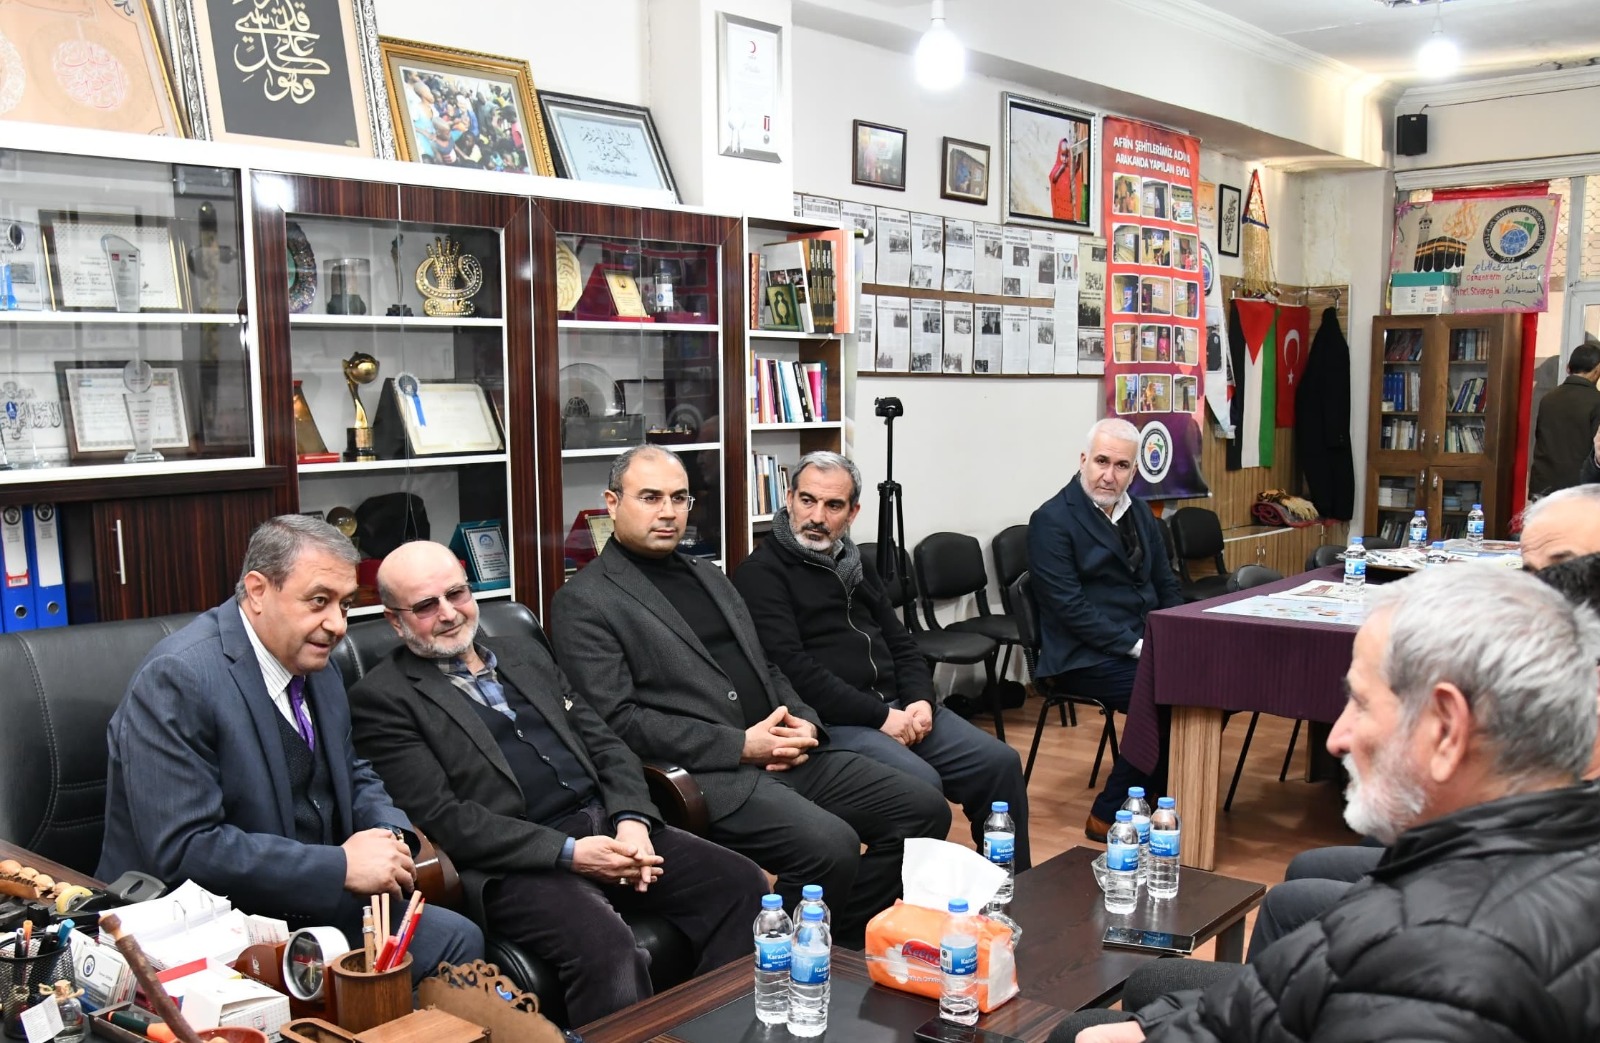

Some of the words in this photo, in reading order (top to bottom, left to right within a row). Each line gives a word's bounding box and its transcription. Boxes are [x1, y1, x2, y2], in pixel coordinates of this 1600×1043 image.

[1113, 136, 1133, 149] AFRİN
[1135, 139, 1173, 157] ŞEHİTLERİMİZ
[1116, 153, 1149, 168] ARAKANDA
